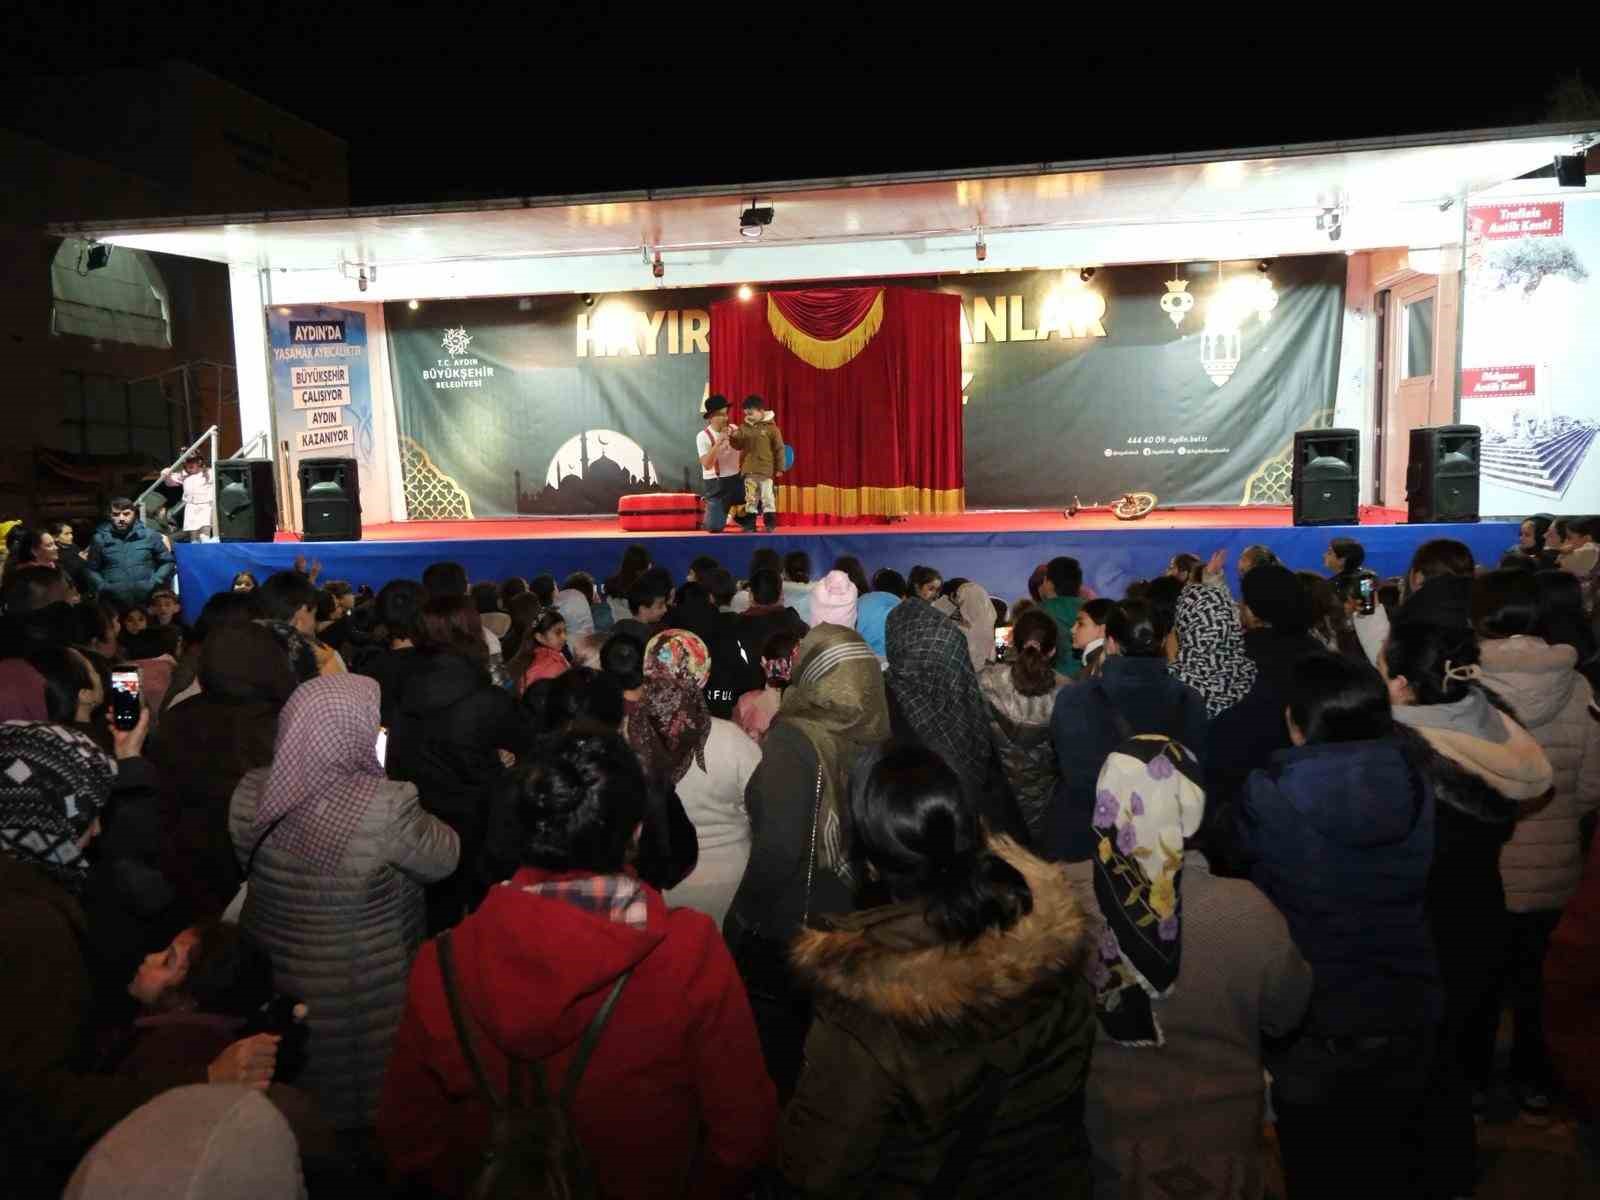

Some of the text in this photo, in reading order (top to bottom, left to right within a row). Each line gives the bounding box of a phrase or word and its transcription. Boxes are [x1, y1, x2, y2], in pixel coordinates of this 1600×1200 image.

[295, 325, 342, 341] AYDIN'DA
[454, 358, 478, 366] AYDIN
[423, 366, 494, 379] BÜYÜKŞEHİR
[436, 379, 482, 389] BELEDİYESİ
[312, 411, 337, 424] AYDIN
[302, 429, 348, 446] KAZANIYOR
